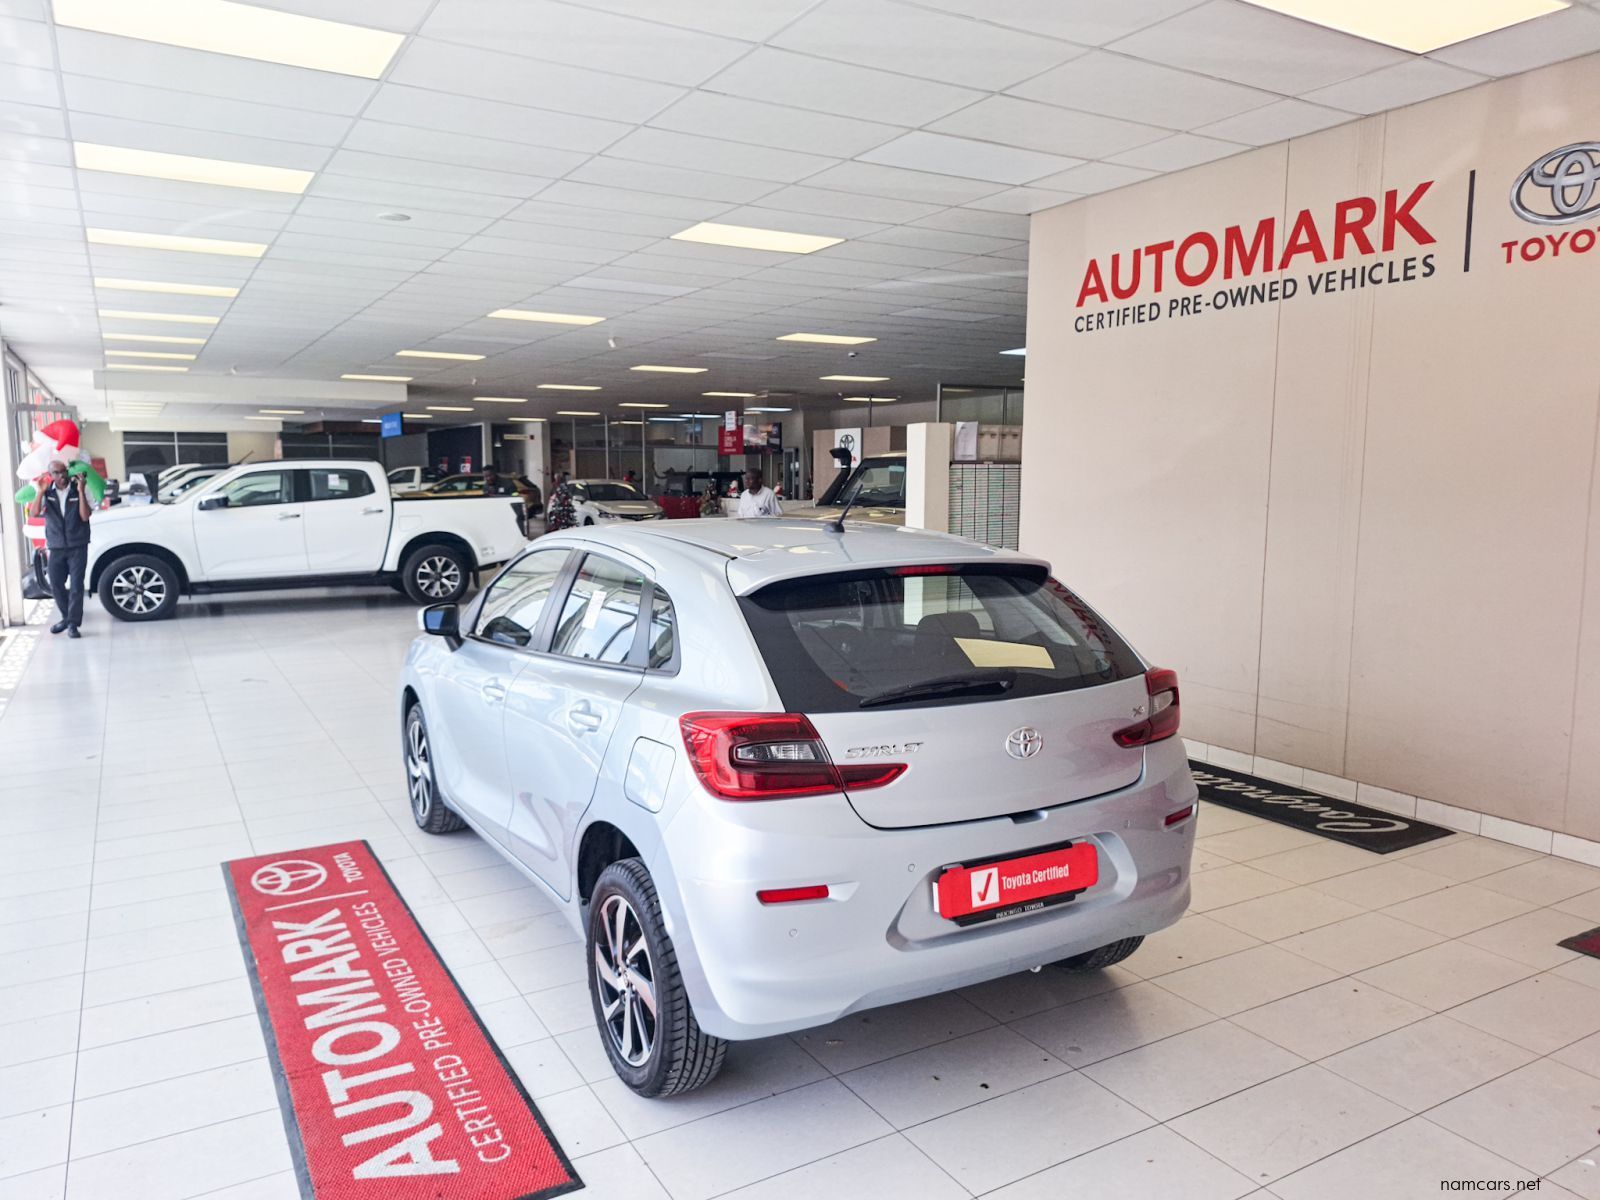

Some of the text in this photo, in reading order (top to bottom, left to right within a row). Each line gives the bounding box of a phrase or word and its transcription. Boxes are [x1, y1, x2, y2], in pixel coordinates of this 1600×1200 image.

[1075, 180, 1437, 308] AUTOMARK
[1501, 226, 1600, 264] TOYO
[1074, 253, 1437, 333] CERTIFIED PRE-OWNED VEHICLES
[846, 741, 925, 759] STARLET
[333, 851, 365, 884] TOYOTA
[1001, 864, 1070, 890] Toyota Certified
[271, 907, 461, 1180] AUTOMARK
[353, 901, 511, 1165] CERTIFIED PRE-OWNED VEHICLES
